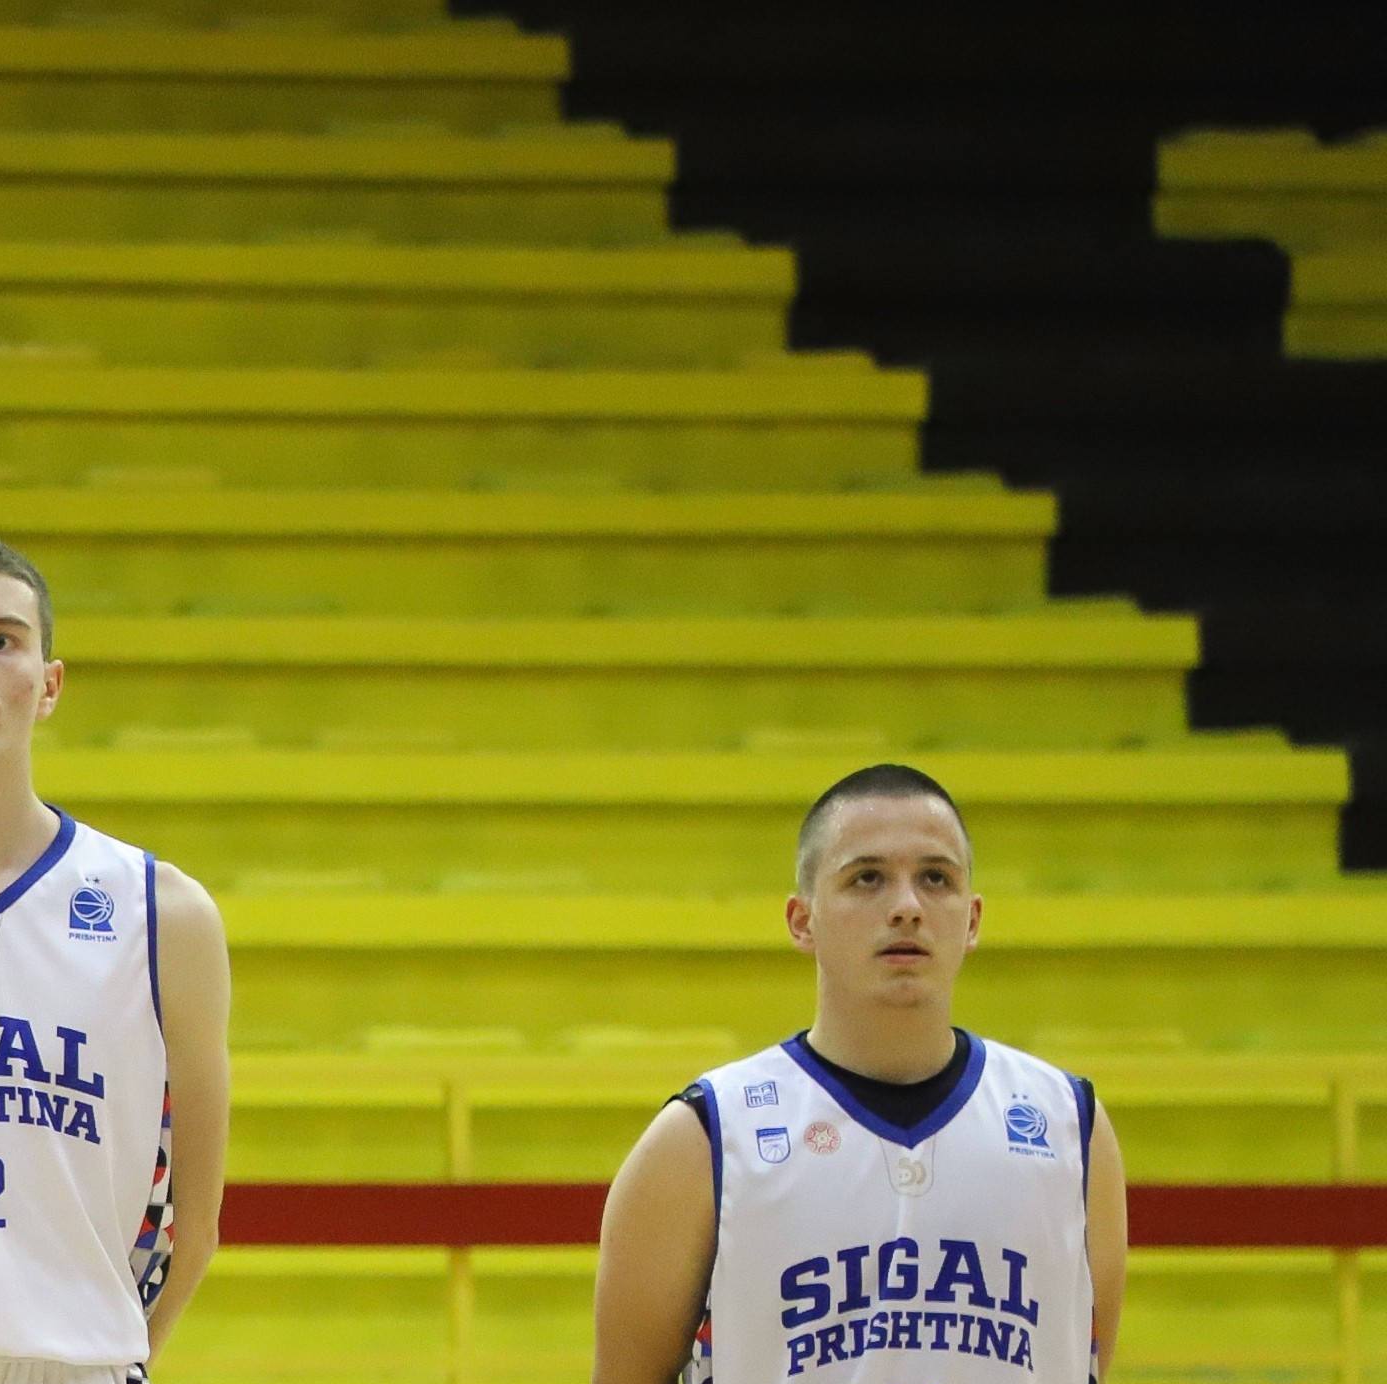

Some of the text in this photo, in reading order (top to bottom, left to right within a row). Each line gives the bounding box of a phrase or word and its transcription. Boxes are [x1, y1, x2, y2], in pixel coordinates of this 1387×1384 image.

[68, 932, 117, 943] PRISHTINA
[780, 1237, 1039, 1328] SIGAL
[787, 1312, 1035, 1376] PRISHTINA
